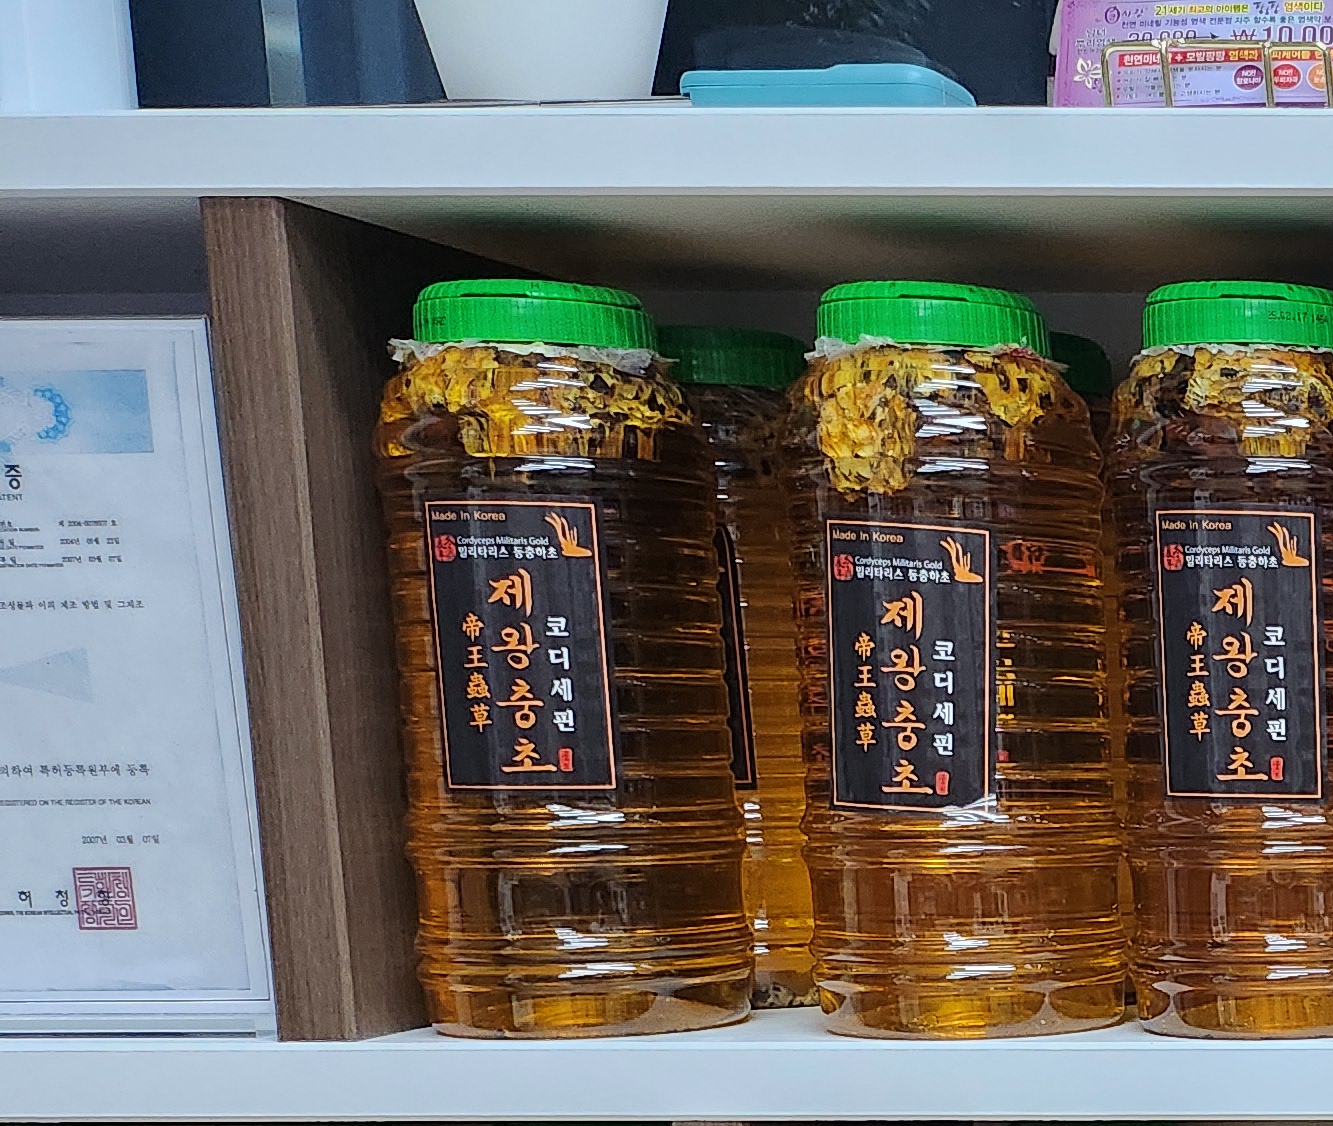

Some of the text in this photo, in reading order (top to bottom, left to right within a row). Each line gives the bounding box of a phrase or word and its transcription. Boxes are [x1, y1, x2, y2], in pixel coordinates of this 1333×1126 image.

[488, 568, 558, 772] 제왕충초
[545, 616, 576, 732] 코디세핀
[881, 590, 934, 794] 제왕충초
[1212, 577, 1270, 781] 제왕충초
